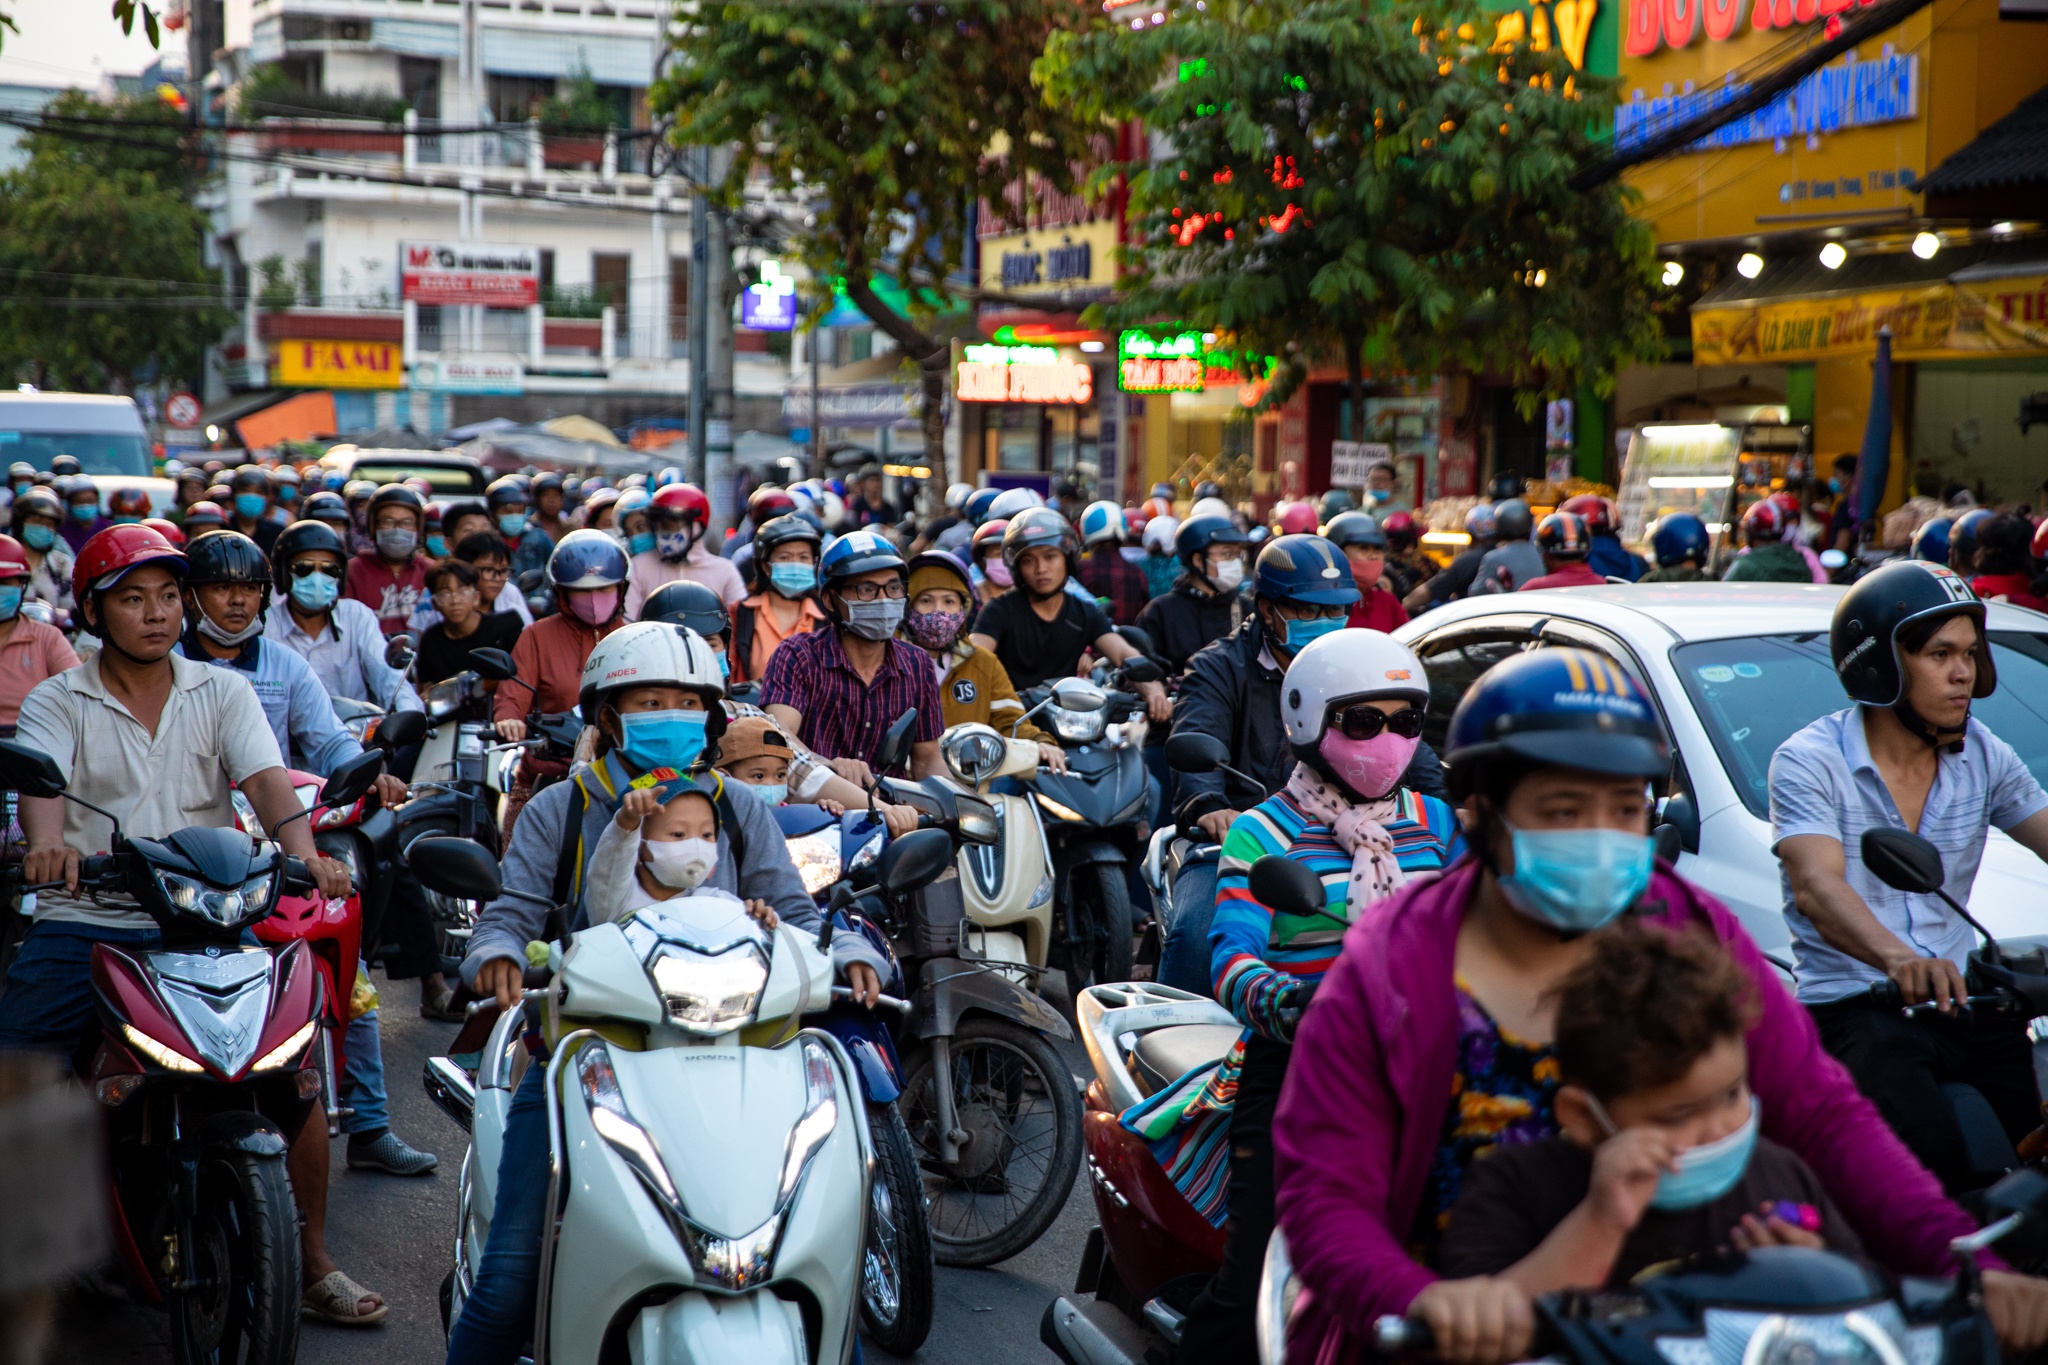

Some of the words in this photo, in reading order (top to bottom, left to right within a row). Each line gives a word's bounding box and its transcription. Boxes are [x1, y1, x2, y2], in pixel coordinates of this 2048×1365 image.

[957, 361, 1009, 402] KIM
[605, 667, 637, 681] ANDES
[956, 683, 975, 701] JS
